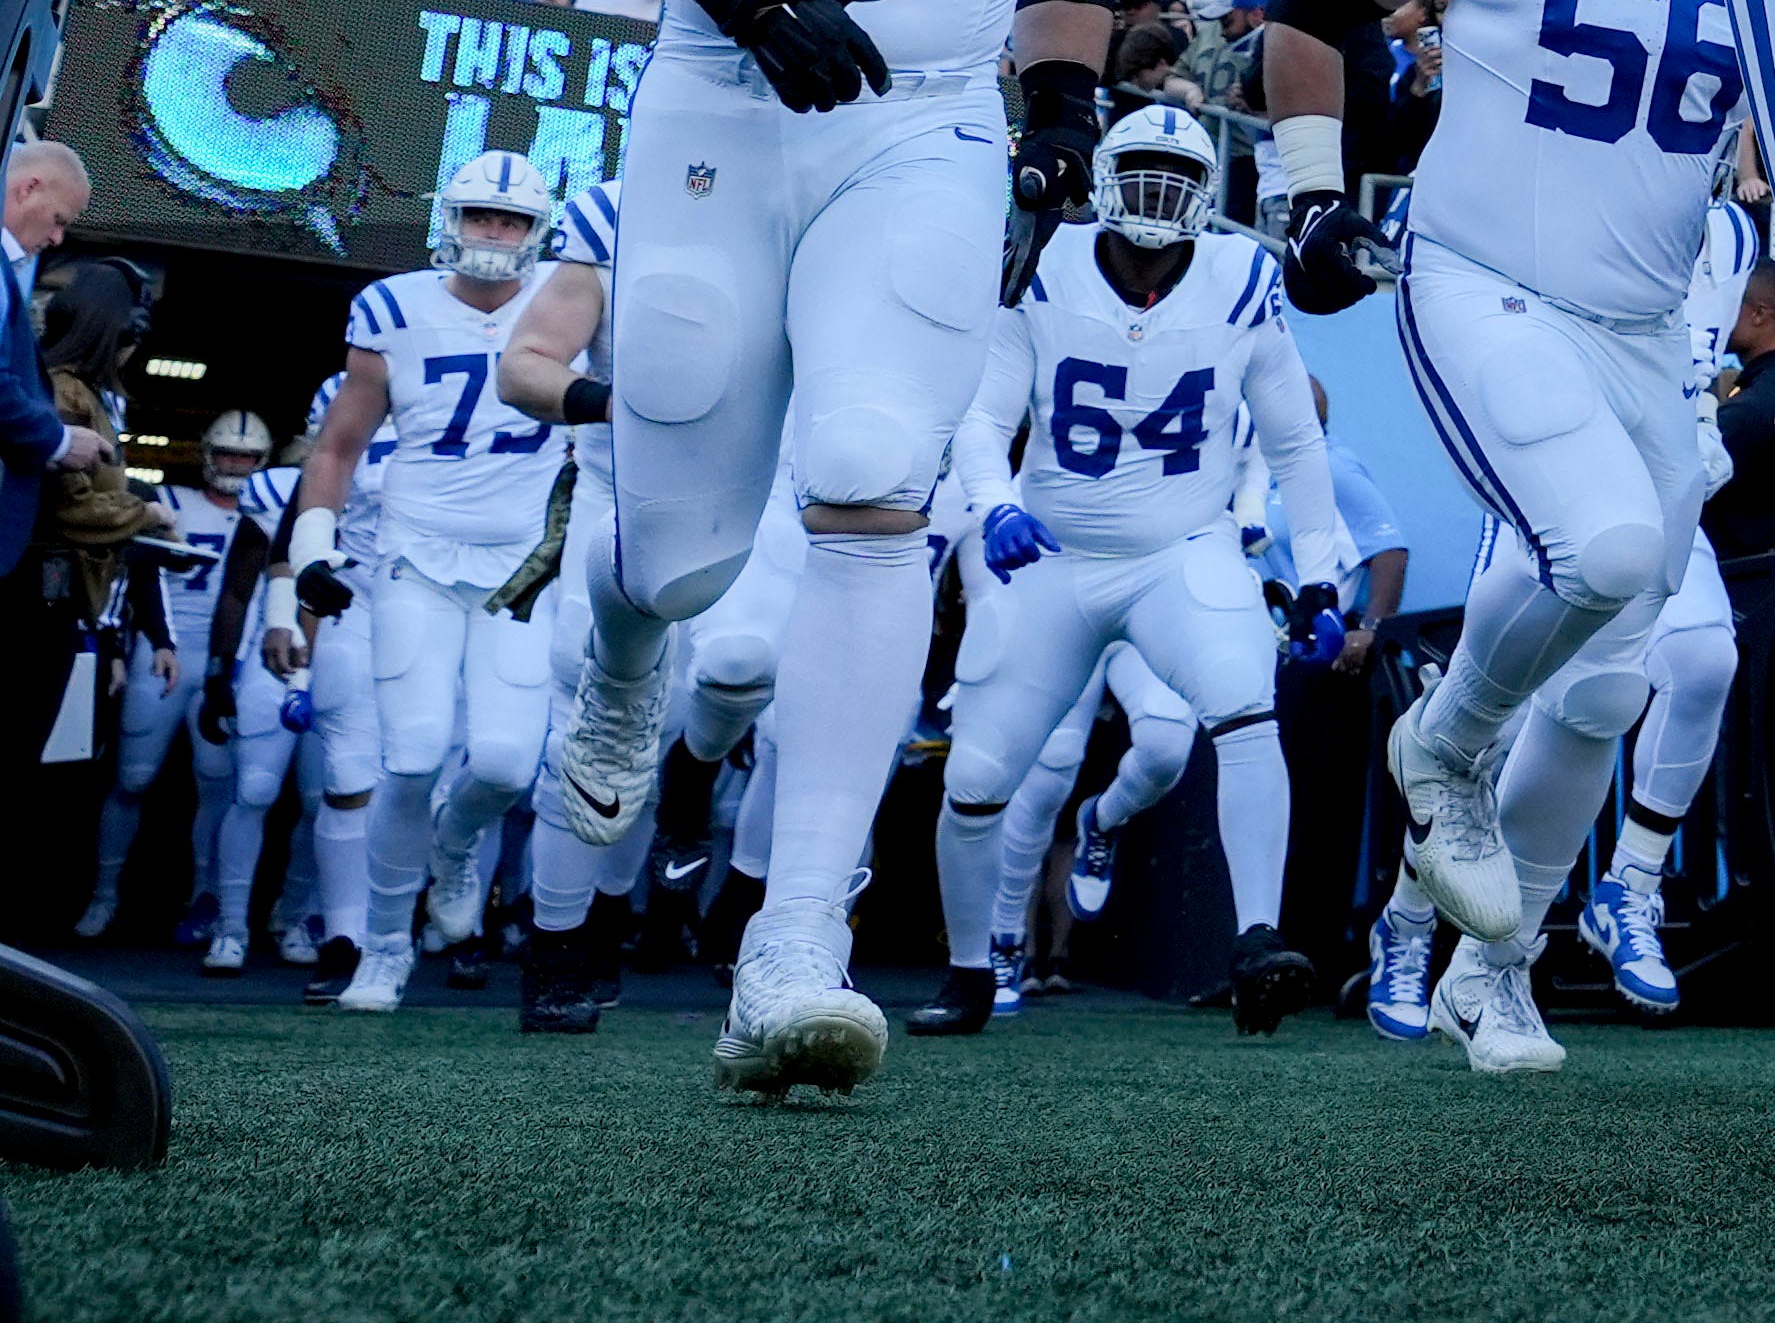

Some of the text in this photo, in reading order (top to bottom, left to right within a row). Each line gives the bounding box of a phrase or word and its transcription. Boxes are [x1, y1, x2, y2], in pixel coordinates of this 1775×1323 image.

[419, 10, 652, 114] THIS IS
[1051, 356, 1215, 479] 64
